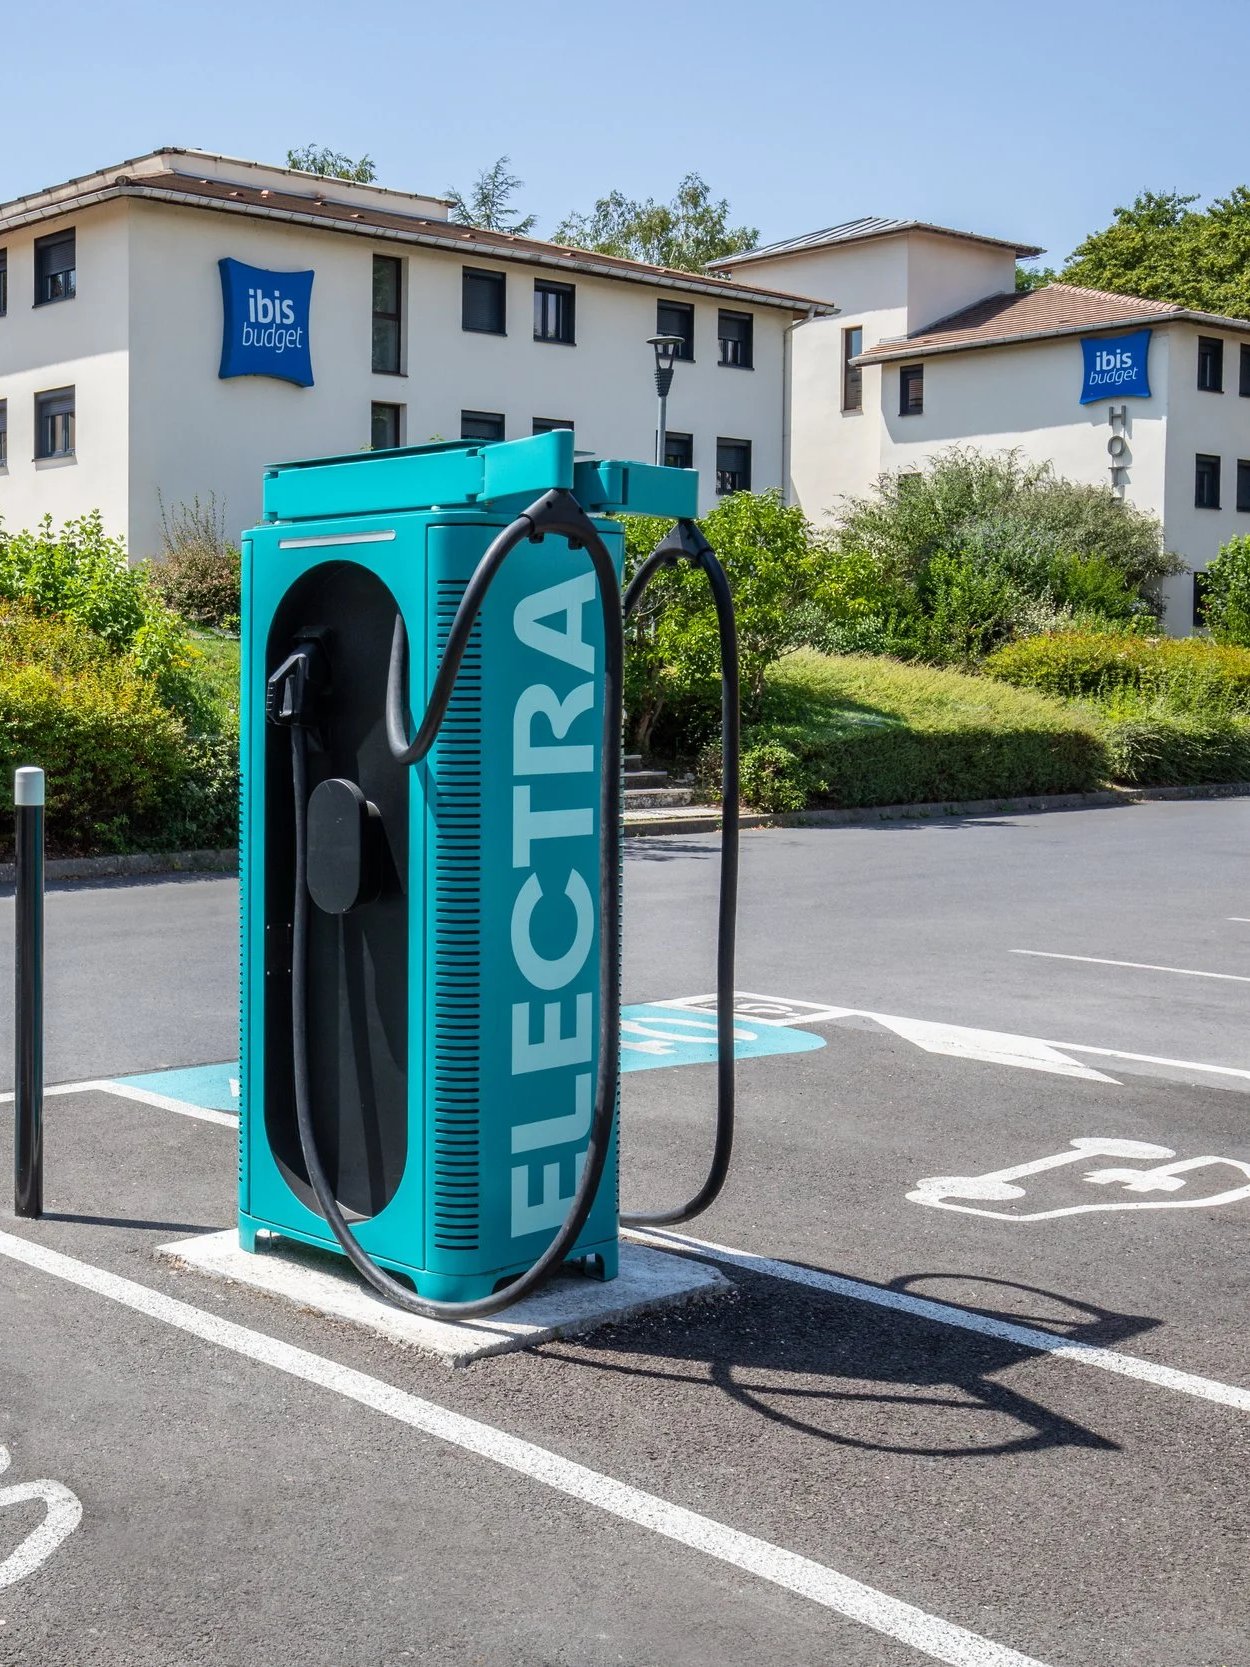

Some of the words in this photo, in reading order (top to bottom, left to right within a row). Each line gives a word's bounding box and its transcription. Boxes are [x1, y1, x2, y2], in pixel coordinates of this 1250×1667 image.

[248, 288, 295, 325] ibis
[242, 321, 303, 353] budget
[1089, 366, 1139, 385] budget
[1095, 349, 1132, 371] ibis
[1107, 405, 1127, 504] HOT
[511, 570, 597, 1239] ELECTRA
